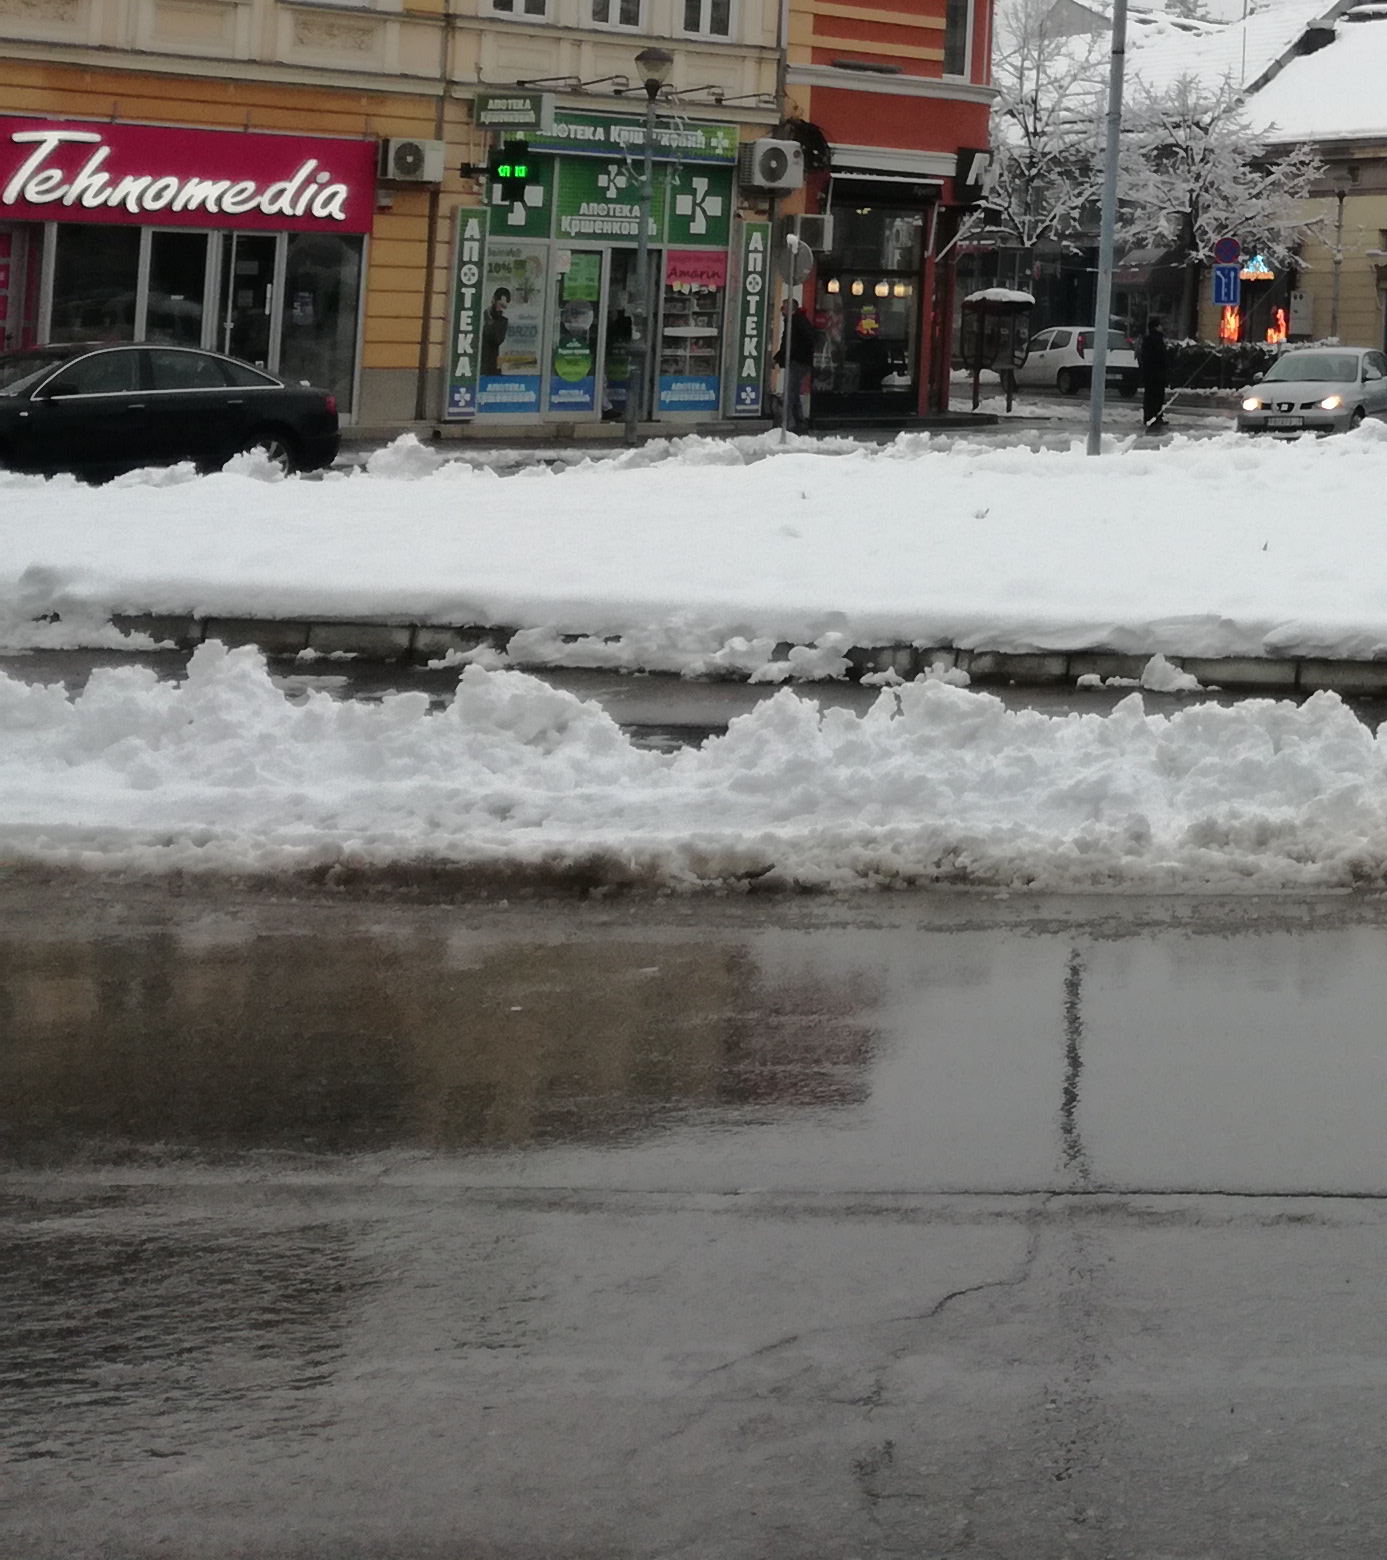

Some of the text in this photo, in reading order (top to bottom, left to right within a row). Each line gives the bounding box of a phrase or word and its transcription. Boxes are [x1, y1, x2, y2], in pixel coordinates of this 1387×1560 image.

[487, 98, 532, 110] АПОТЕКА
[2, 130, 349, 221] Tehnomedia
[560, 215, 657, 236] Кршенковћ
[579, 202, 641, 217] АПОТЕКА
[454, 218, 481, 377] АПОТЕКА
[741, 232, 763, 377] АПОТЕКА
